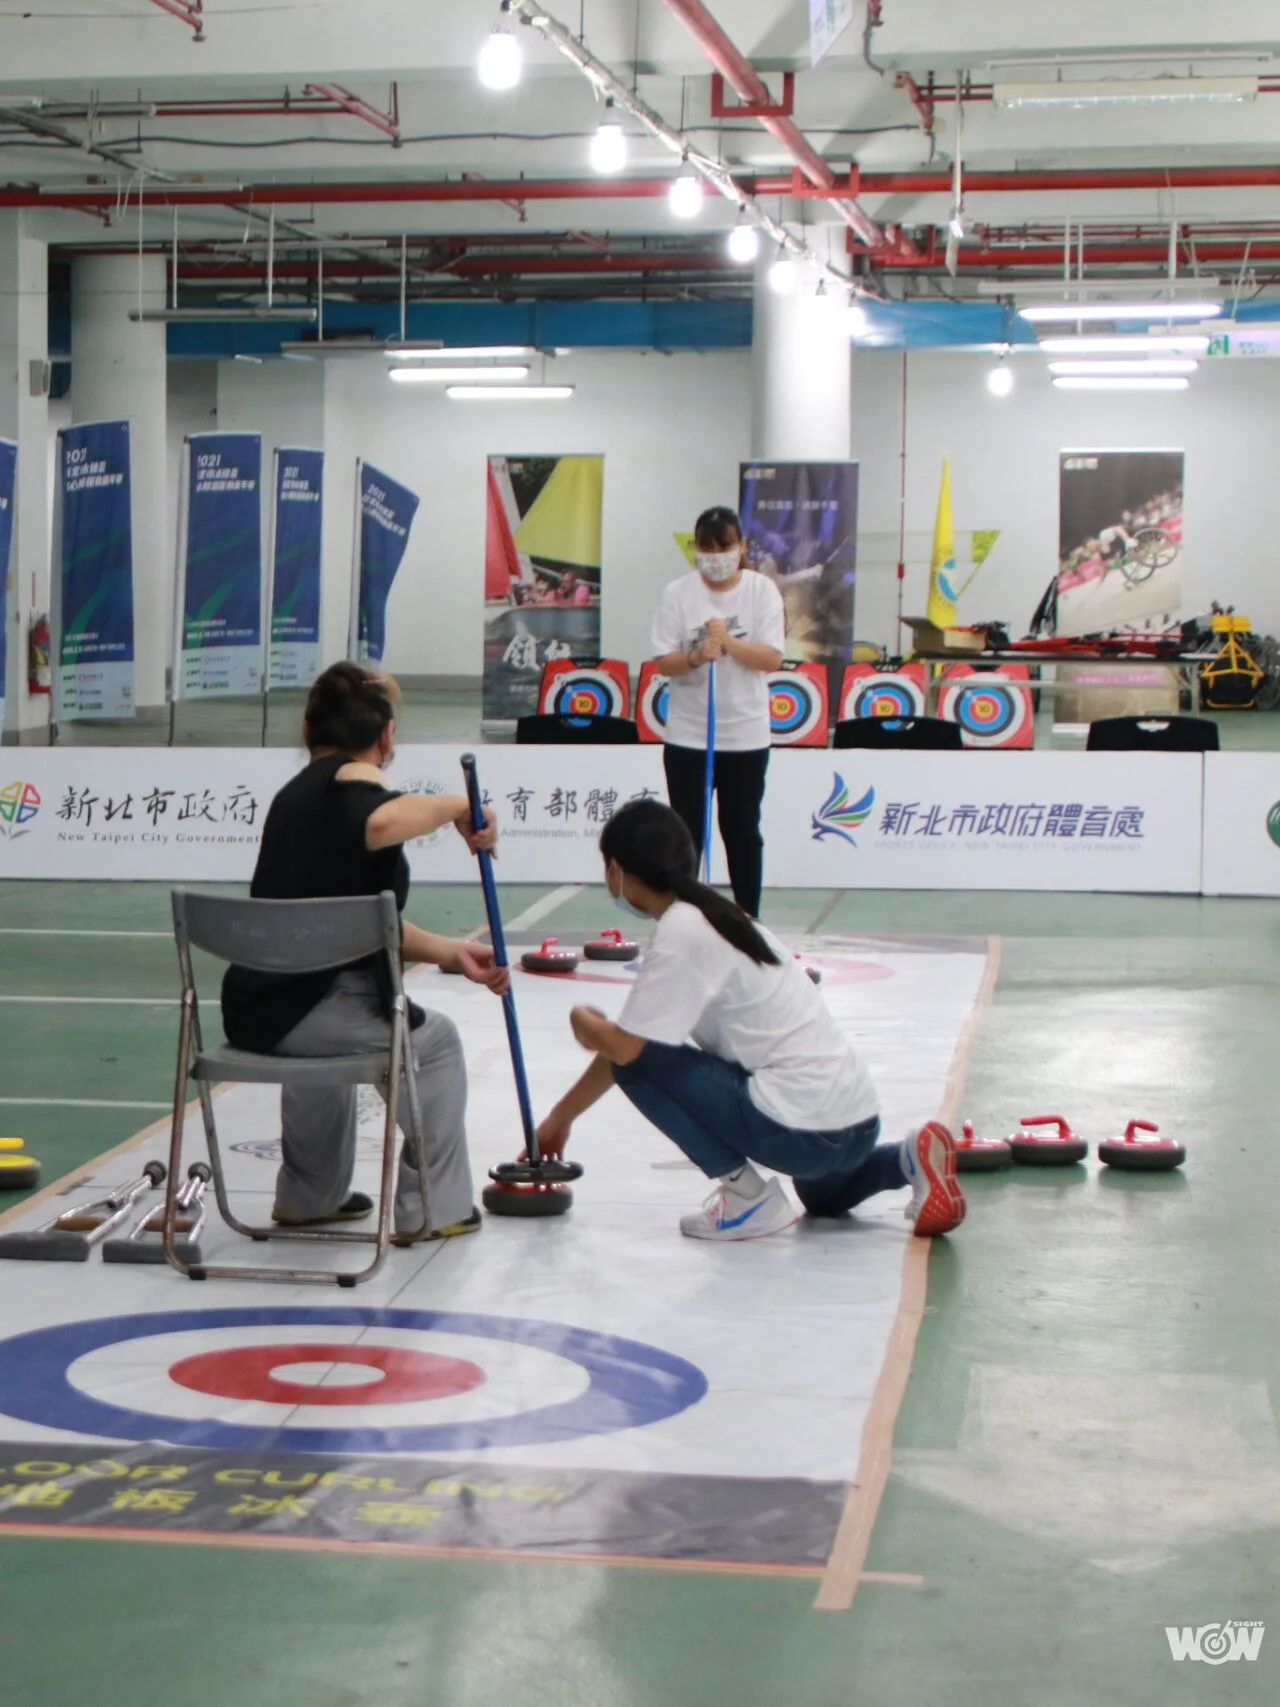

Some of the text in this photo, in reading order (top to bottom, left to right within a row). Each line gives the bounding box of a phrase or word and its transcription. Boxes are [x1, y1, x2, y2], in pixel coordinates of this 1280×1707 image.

[55, 785, 259, 827] 新北市政府
[878, 801, 1146, 838] 新北市政府體育處
[57, 833, 261, 845] New Taipei City Government
[214, 1468, 564, 1501] CURLING
